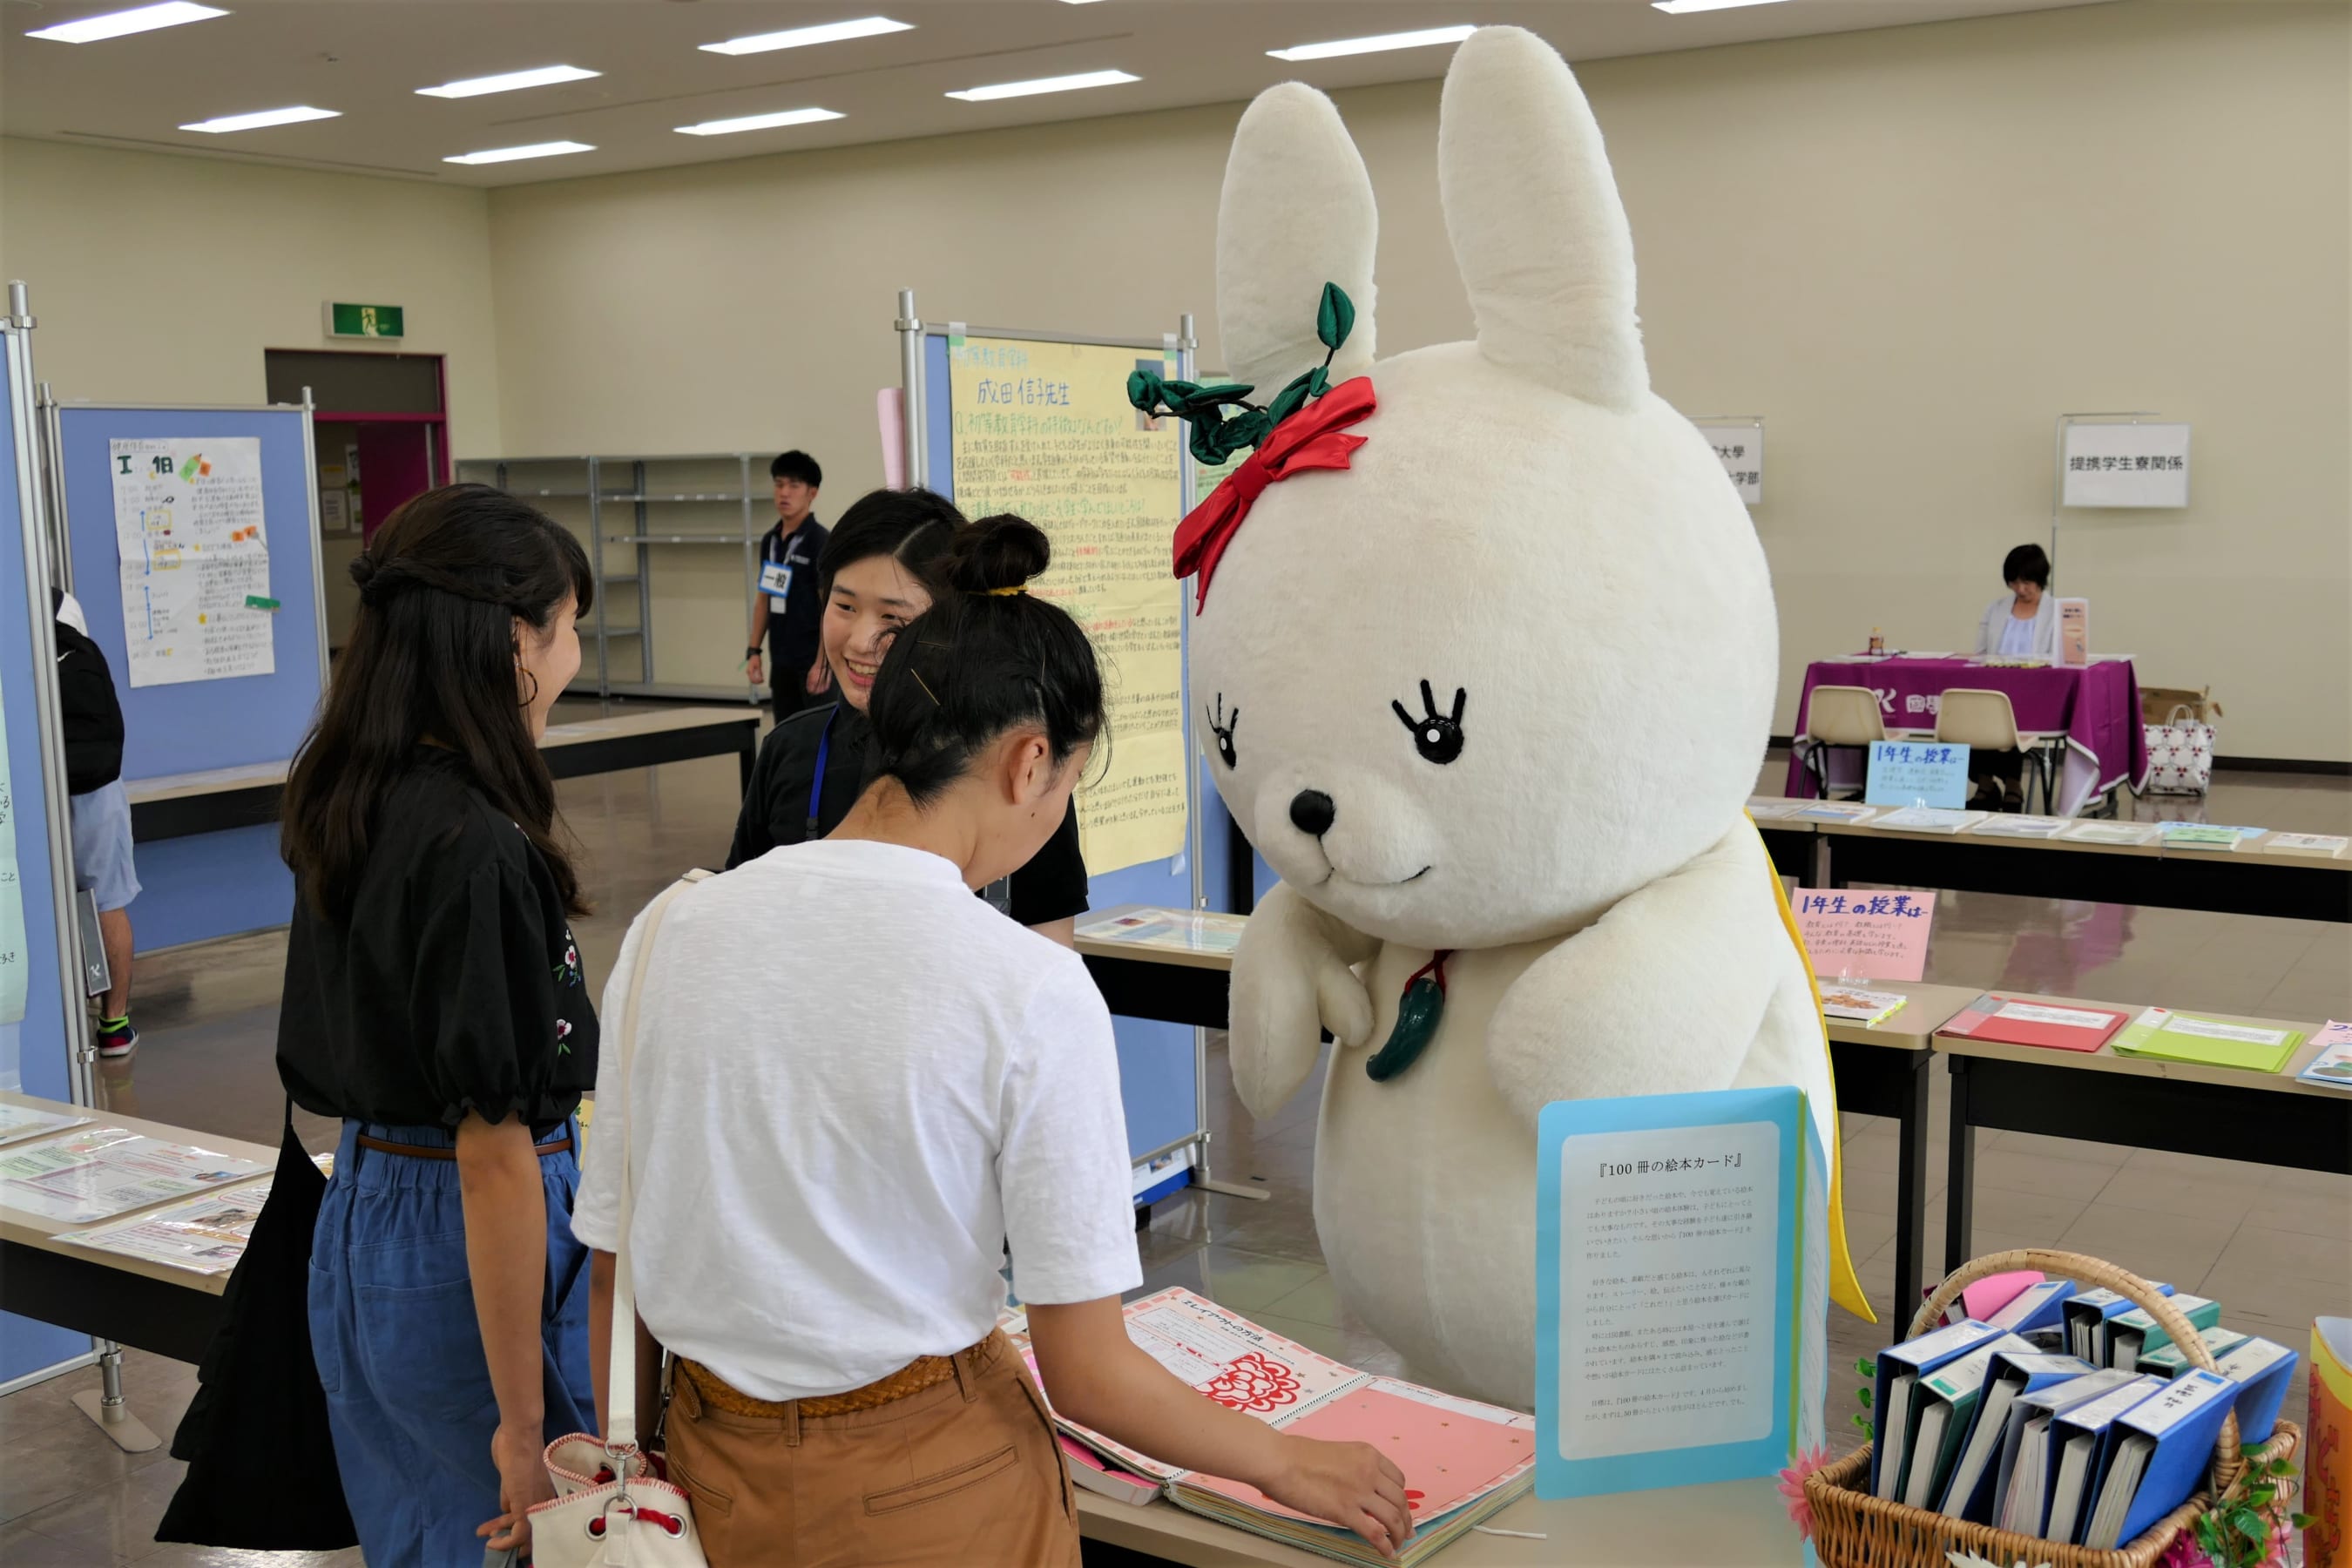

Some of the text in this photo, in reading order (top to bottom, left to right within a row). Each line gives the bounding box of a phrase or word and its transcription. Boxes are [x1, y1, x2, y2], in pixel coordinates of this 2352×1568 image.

[2070, 456, 2183, 471] 提携学生寮関係
